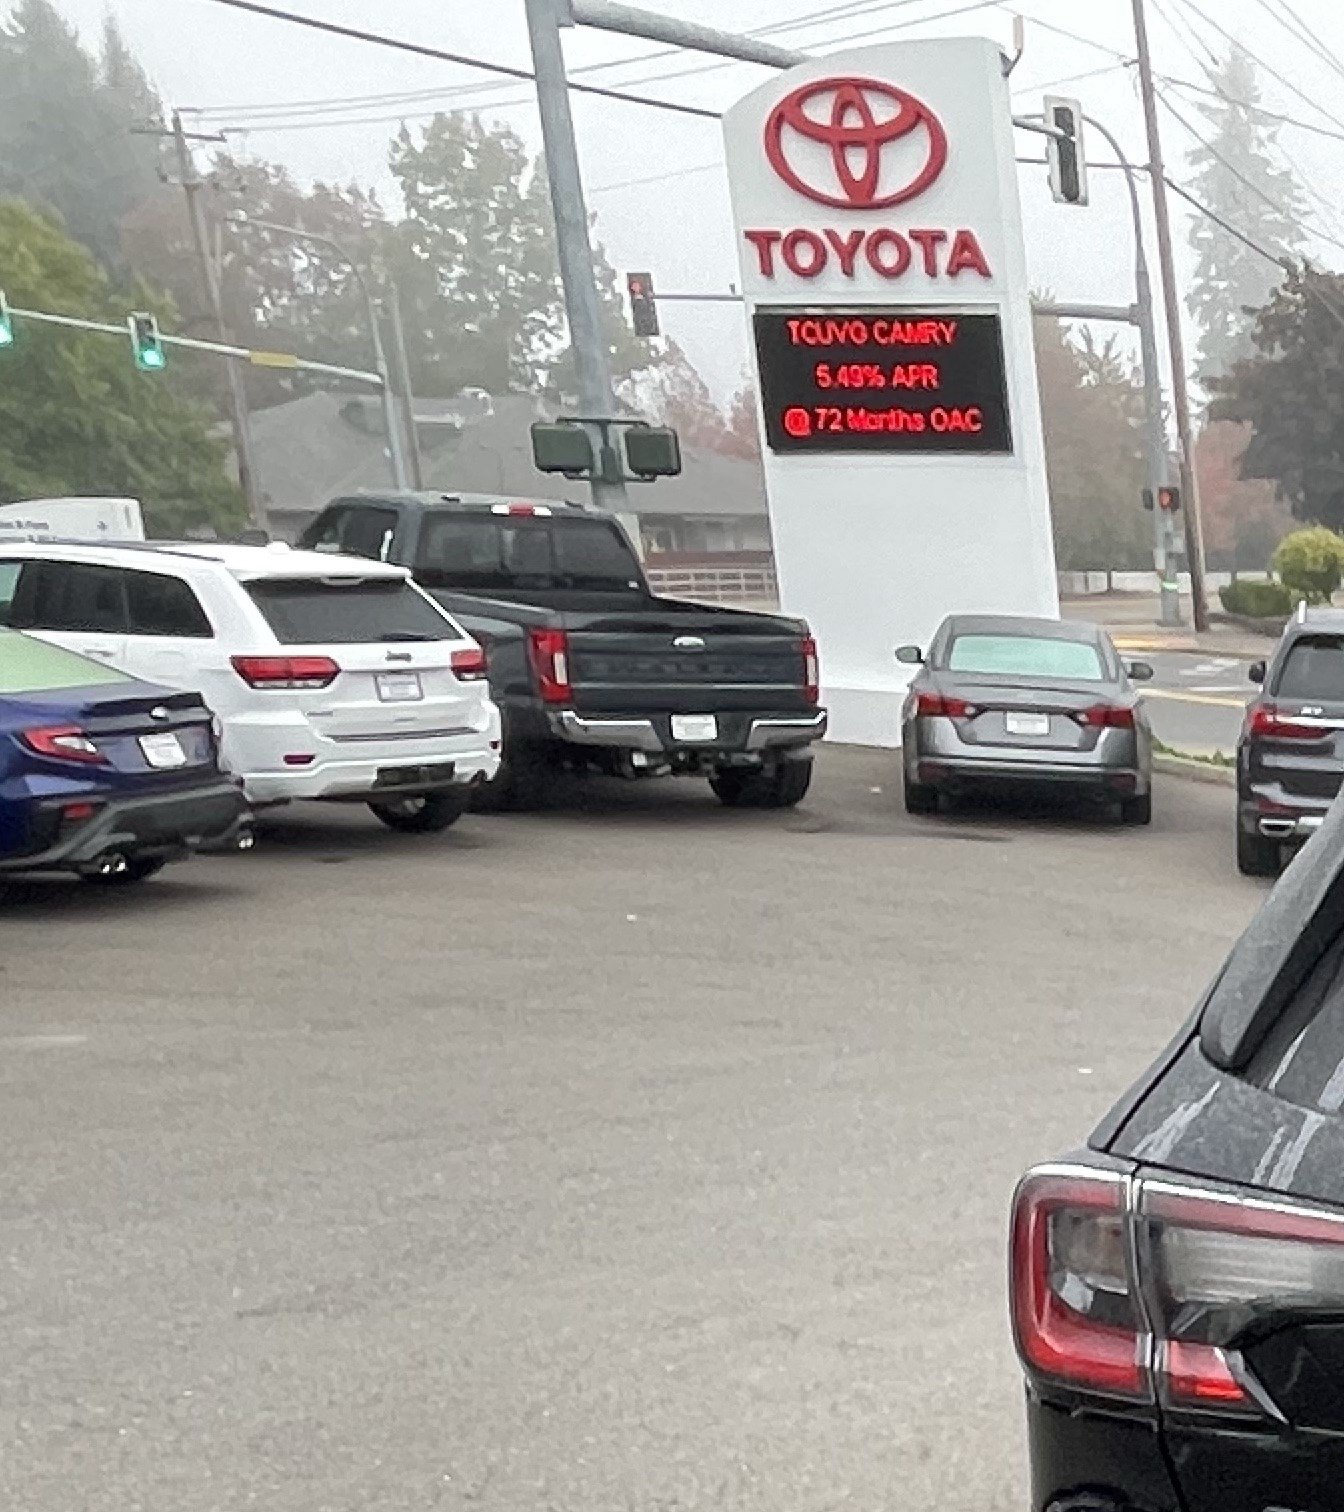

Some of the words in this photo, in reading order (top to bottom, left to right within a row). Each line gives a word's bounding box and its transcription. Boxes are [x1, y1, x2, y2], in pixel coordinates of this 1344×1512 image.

[744, 229, 992, 278] TOYOTA
[872, 320, 957, 346] CAMRY
[815, 363, 886, 388] 5.49%
[892, 364, 940, 388] APR
[815, 408, 843, 430] 72
[846, 408, 925, 432] Months
[930, 407, 983, 432] OAC
